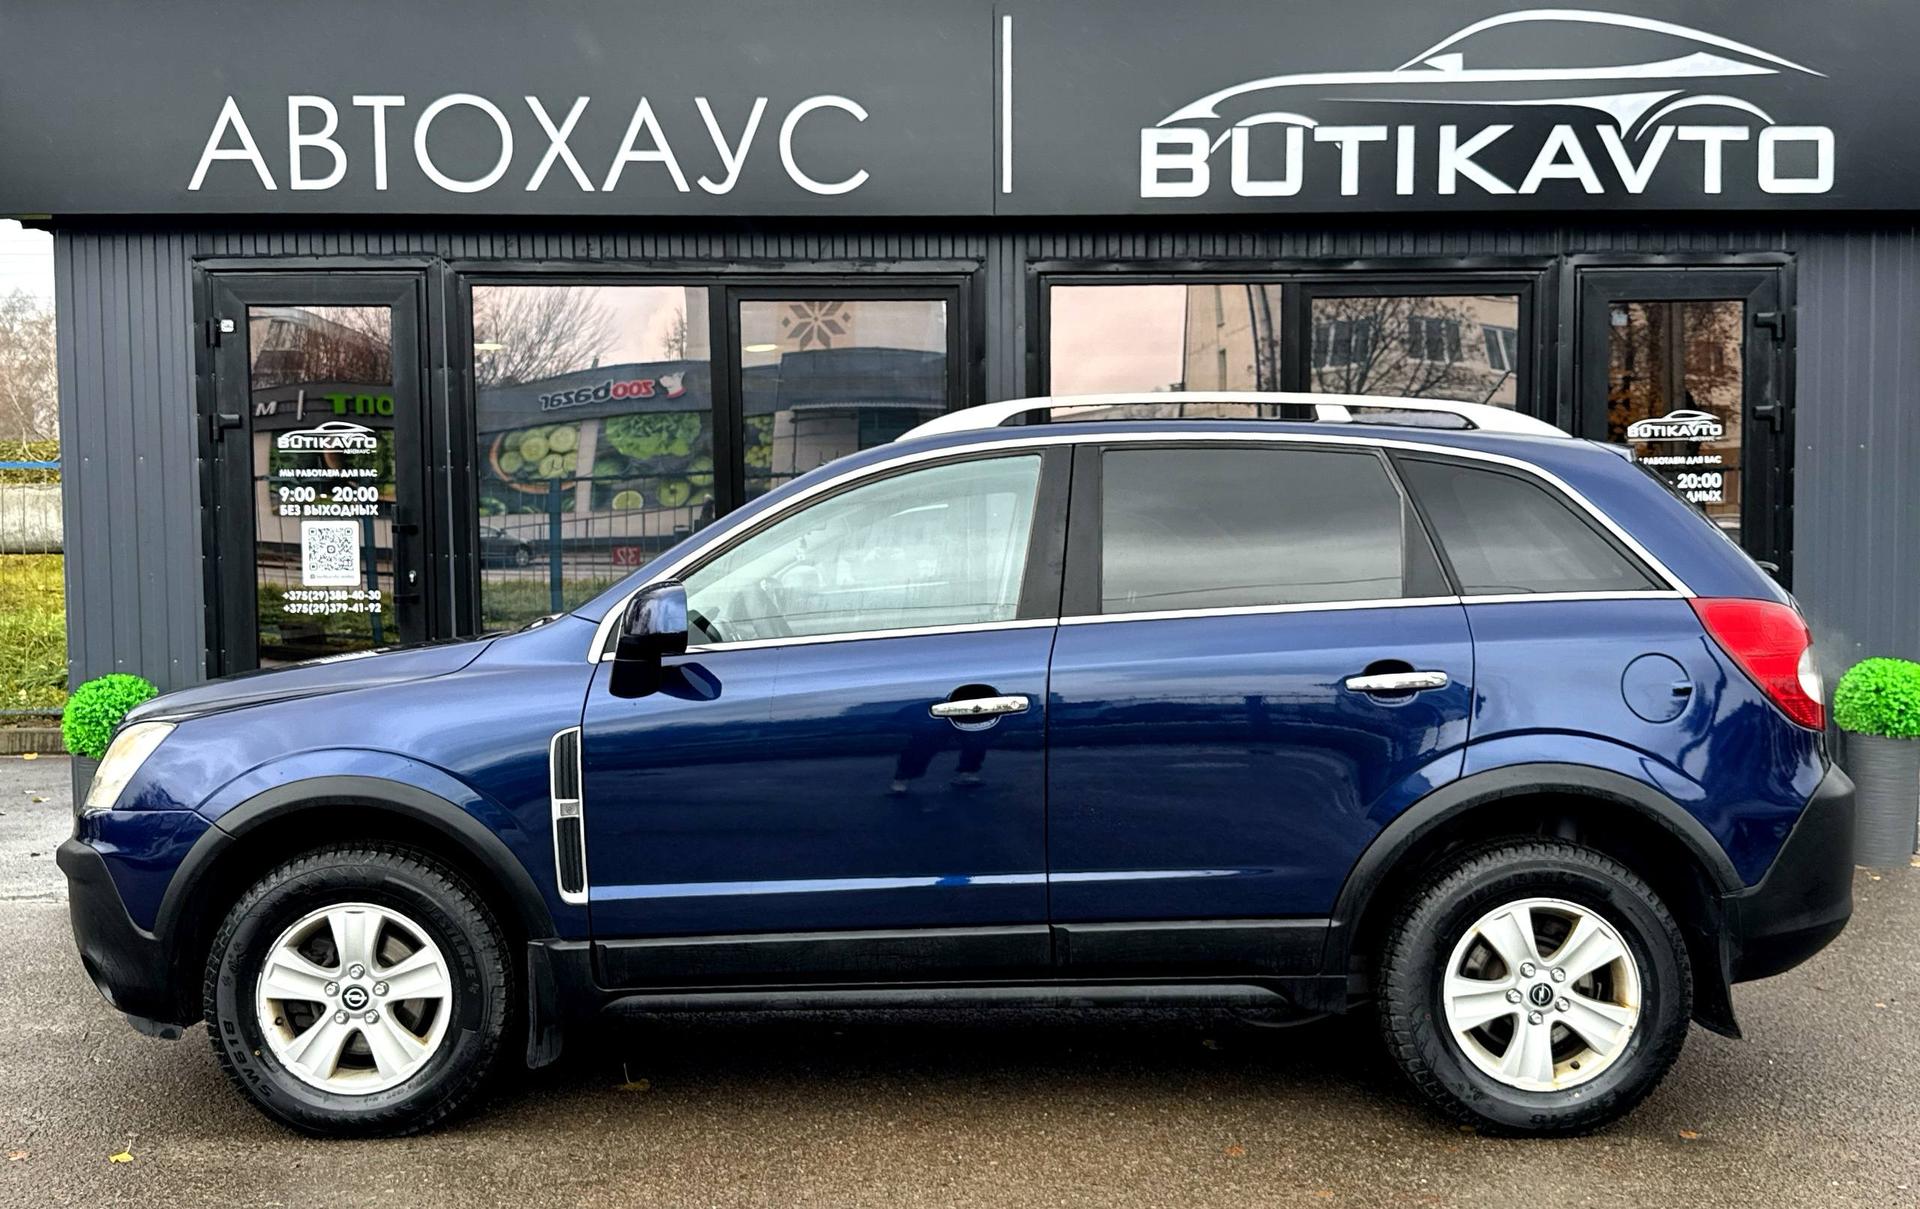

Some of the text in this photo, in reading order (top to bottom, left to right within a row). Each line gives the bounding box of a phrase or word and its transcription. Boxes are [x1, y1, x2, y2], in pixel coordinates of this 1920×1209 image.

[188, 93, 869, 195] АВТОХАУС
[1140, 124, 1835, 198] BUTIKAVTO
[1627, 423, 1723, 437] BUTIKAVTO
[277, 436, 377, 449] BUTIKAVTO
[1704, 455, 1722, 464] ВАС
[279, 469, 378, 478] МЫ РАБОТАЕМ ДЛЯ ВАС
[1677, 472, 1722, 489] 20:00
[279, 486, 316, 502] 9:00
[332, 486, 379, 502] 20:00
[279, 504, 379, 517] БЕЗ ВЫХОДНЫХ
[283, 603, 382, 616] +375(29)379-41-92
